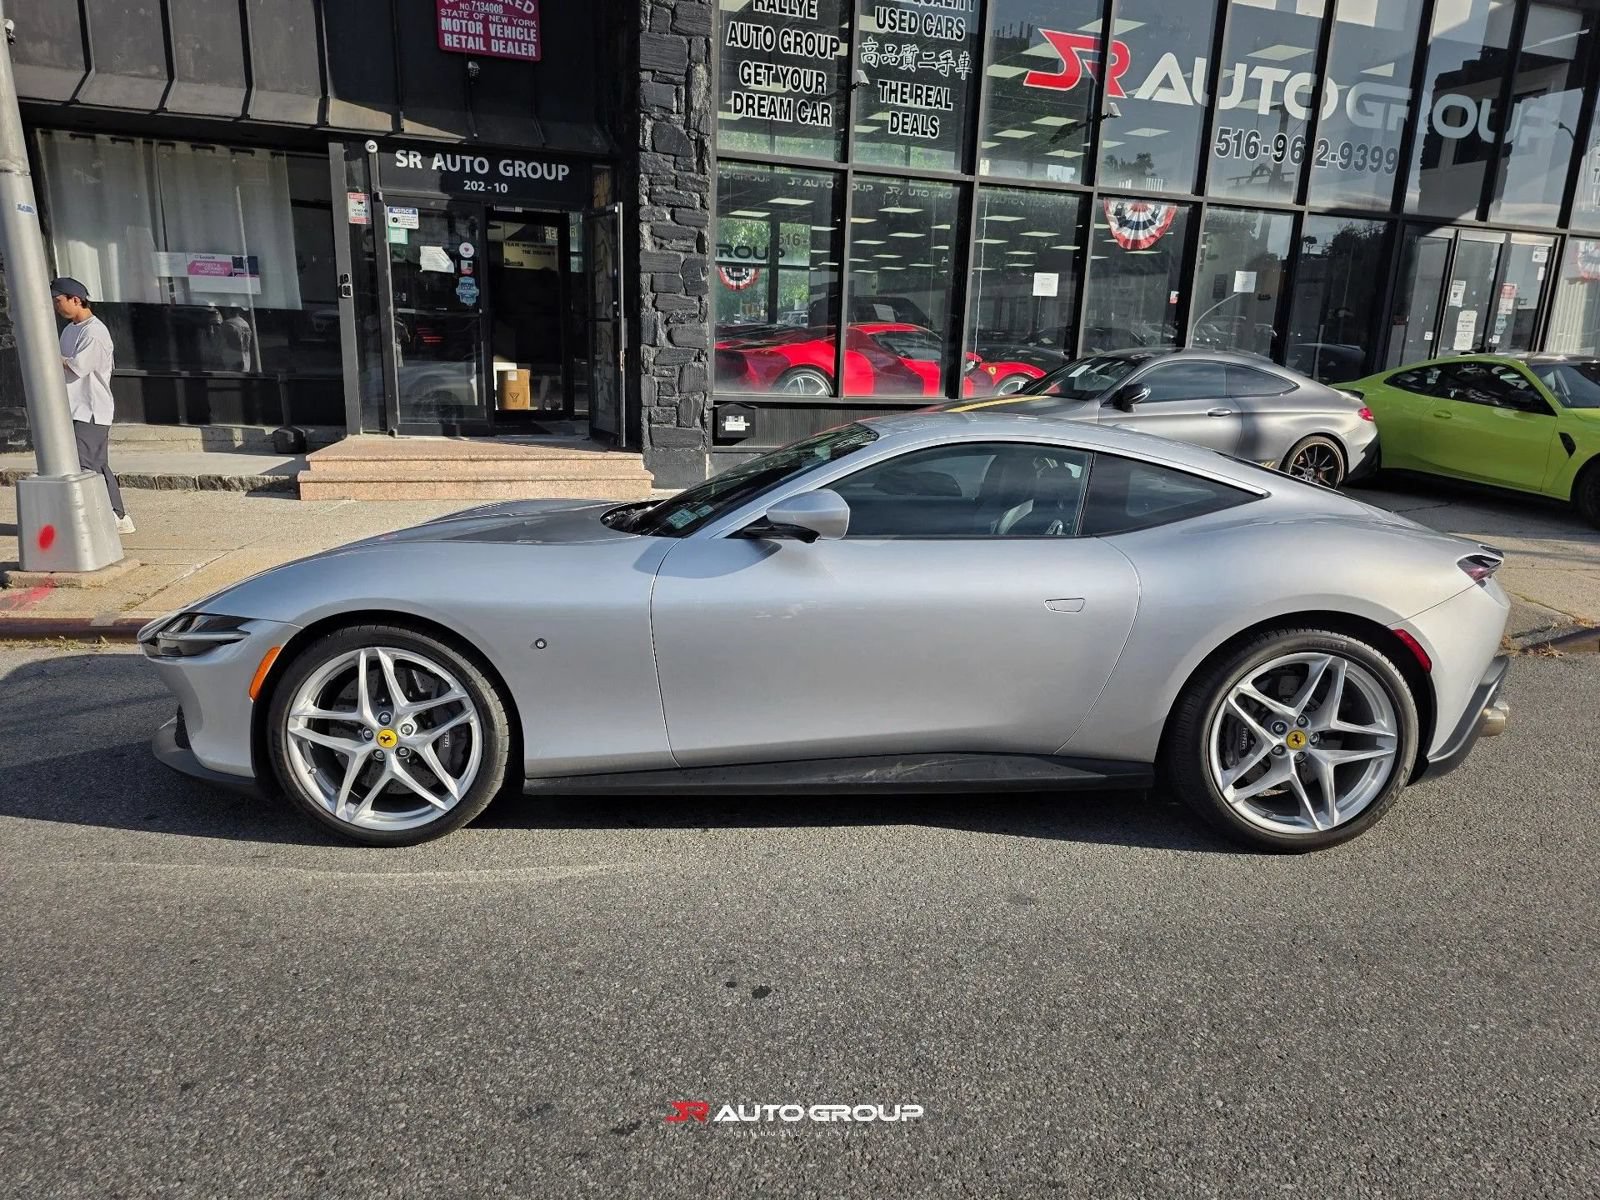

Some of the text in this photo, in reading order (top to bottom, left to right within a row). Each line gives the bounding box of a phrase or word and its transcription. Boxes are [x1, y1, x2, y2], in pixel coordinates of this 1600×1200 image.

[440, 8, 536, 27] STATE OF NEW YORK
[440, 17, 537, 42] MOTOR VEHICLE
[875, 6, 919, 34] USED
[922, 13, 966, 42] CARS
[443, 32, 536, 57] RETAIL DEALER
[726, 21, 840, 61] AUTO GROUP
[860, 35, 972, 80] 高品質二手車
[739, 60, 826, 95] GET YOUR
[878, 79, 953, 111] THE REAL
[1136, 51, 1334, 121] AUTO
[731, 92, 832, 127] DREAM CAR
[888, 112, 940, 139] DEALS
[395, 149, 570, 181] SR AUTO GROUP
[1214, 126, 1399, 174] 516-962-9399
